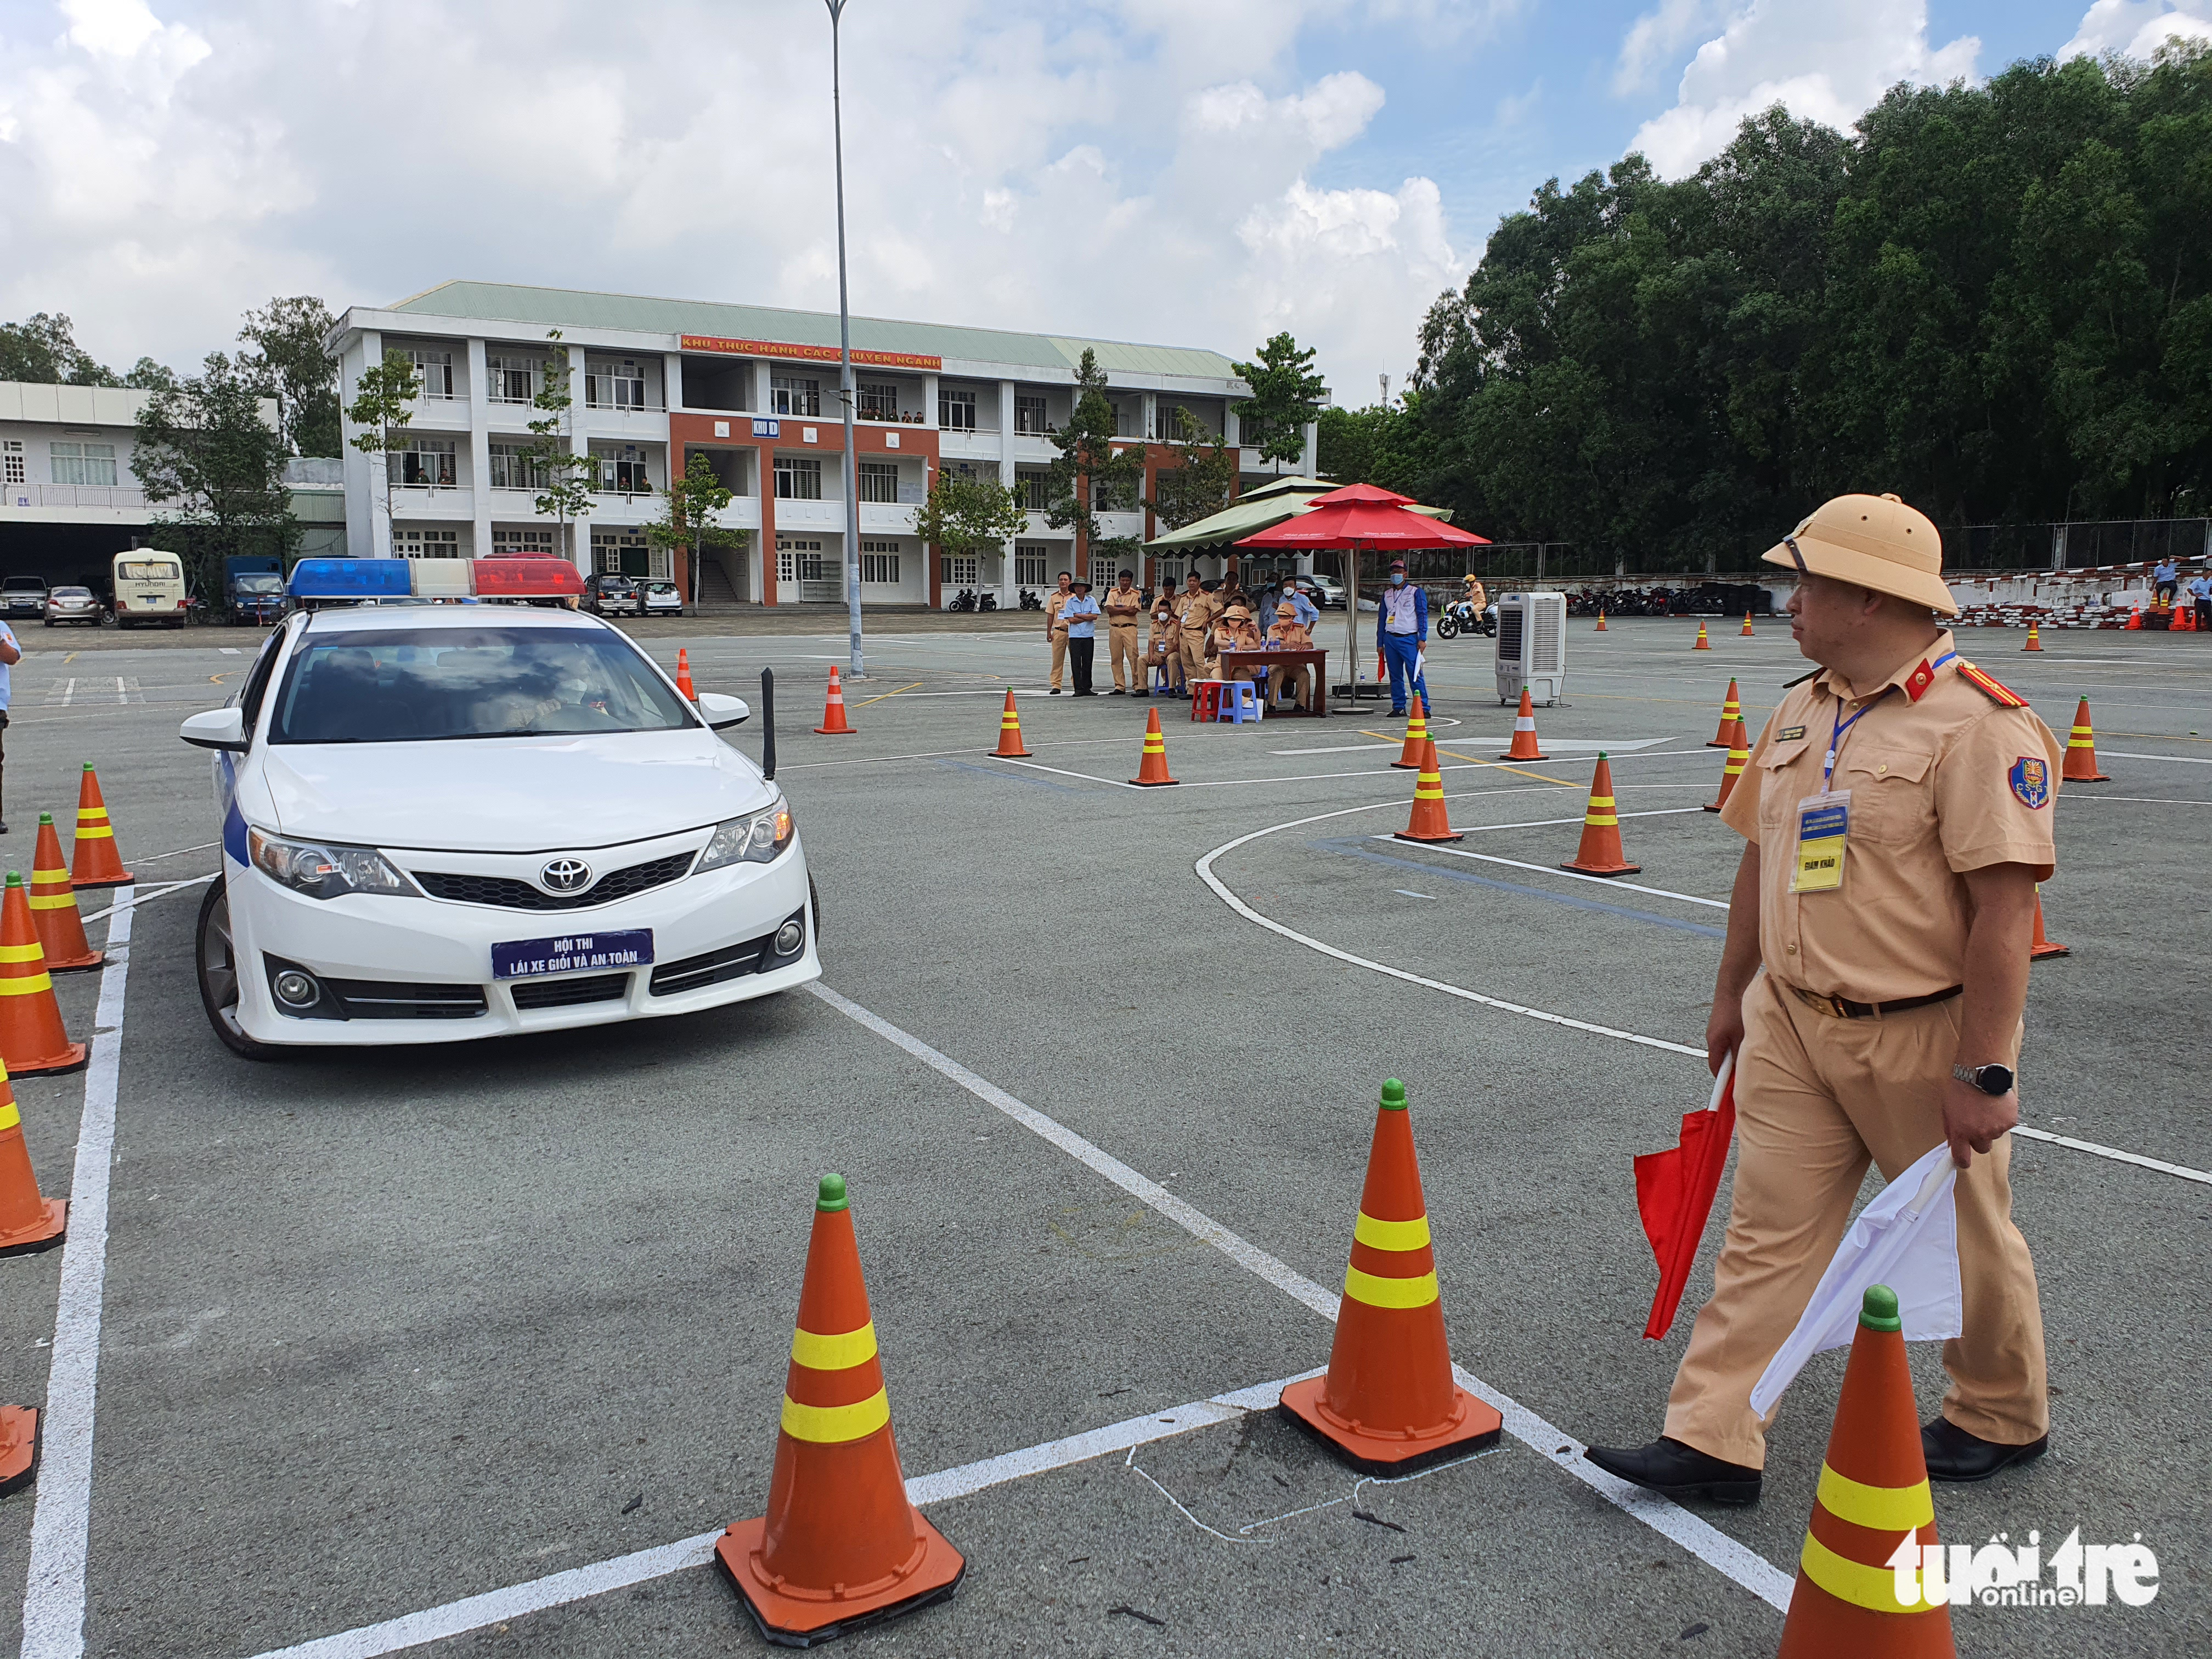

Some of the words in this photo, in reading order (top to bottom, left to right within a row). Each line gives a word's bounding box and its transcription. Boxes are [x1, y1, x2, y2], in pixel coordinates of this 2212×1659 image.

[682, 338, 711, 348] KHU
[717, 341, 753, 353] THỰC
[759, 343, 798, 356] HÀNH
[803, 347, 831, 358] CÁC
[896, 356, 940, 366] NGÀNH
[753, 421, 767, 435] KHU
[769, 421, 778, 435] D
[554, 937, 573, 953] HỘI
[576, 938, 593, 950] THI
[510, 960, 528, 974] LÁI
[531, 960, 545, 972] XE
[549, 954, 571, 970] GIỎI
[573, 953, 588, 968] VÀ
[591, 953, 606, 966] AN
[608, 949, 637, 964] TOÀN
